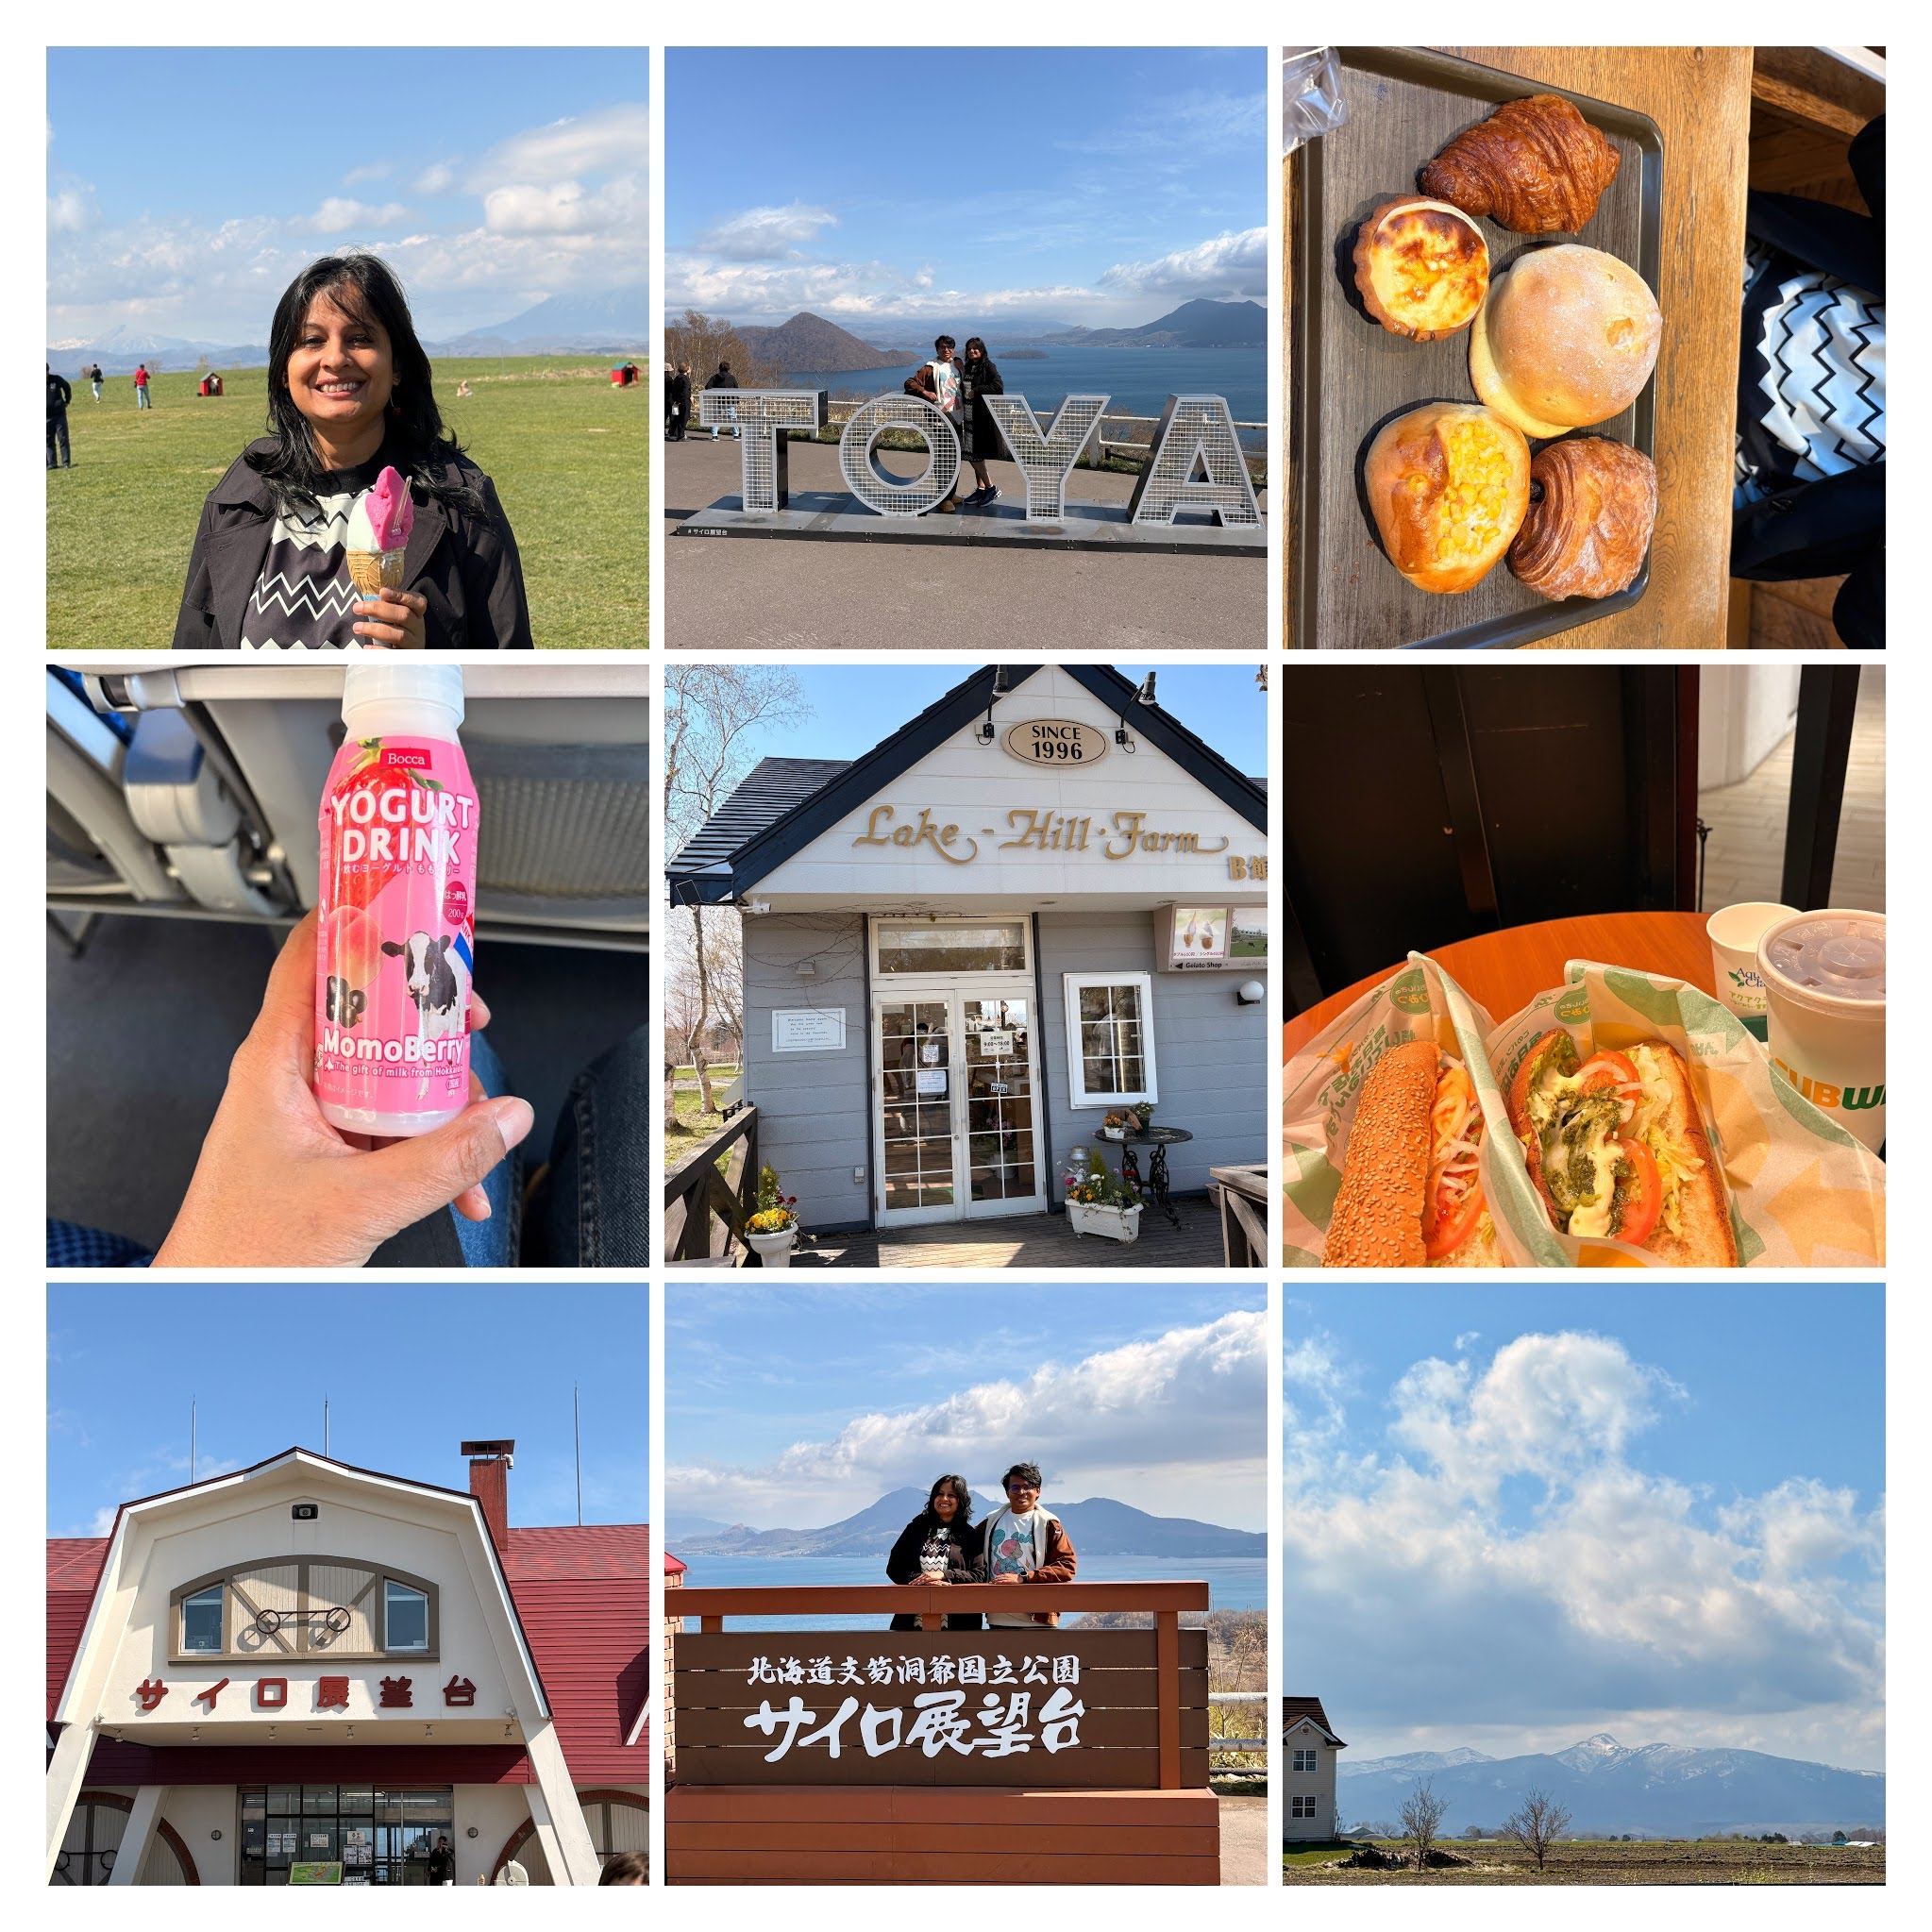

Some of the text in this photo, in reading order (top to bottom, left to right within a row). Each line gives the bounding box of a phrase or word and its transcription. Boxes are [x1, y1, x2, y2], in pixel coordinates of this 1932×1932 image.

[699, 389, 1266, 529] TOYA
[1032, 726, 1082, 741] SINCE
[387, 752, 426, 765] Bocca
[1032, 741, 1083, 760] 1996
[330, 788, 474, 830] YOGURT
[342, 827, 462, 865] DRINK
[852, 804, 978, 865] Lake
[999, 809, 1091, 851] Hill
[1104, 812, 1230, 861] Farm
[343, 863, 412, 875] 飲むヨーグルト
[447, 908, 464, 919] 200g
[324, 1027, 463, 1064] MomoBerry
[335, 1061, 463, 1078] The gift of milk from Hokkaido
[747, 1655, 1081, 1686] 北海道支笏洞爺国立公園
[136, 1674, 478, 1710] サイロ展望台
[743, 1687, 1085, 1763] サイロ展望台
